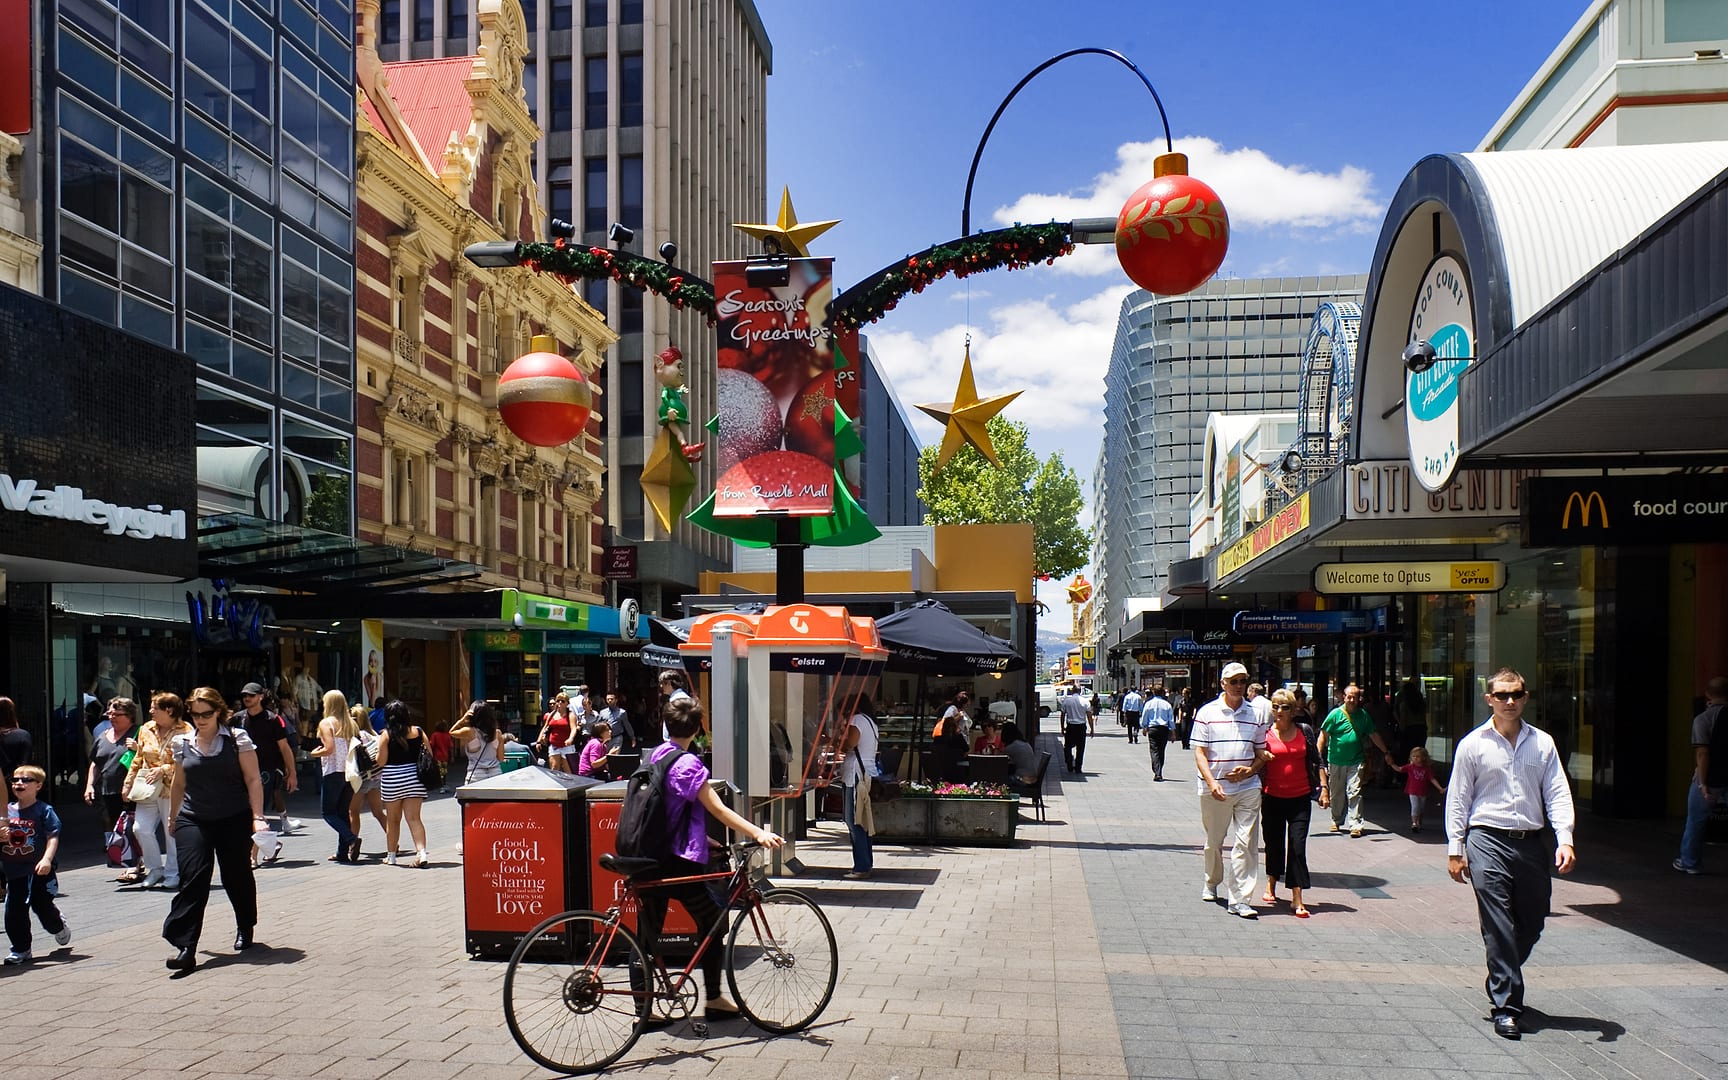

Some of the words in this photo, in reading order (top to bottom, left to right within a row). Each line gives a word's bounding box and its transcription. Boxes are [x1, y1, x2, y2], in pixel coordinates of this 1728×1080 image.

[1436, 270, 1463, 306] COURT
[721, 290, 804, 314] Season's
[731, 320, 830, 349] Greetings
[1425, 441, 1455, 476] SHOPS
[721, 486, 747, 500] from
[751, 485, 794, 499] Rundle
[800, 484, 828, 498] Mall
[1353, 465, 1410, 513] CITI
[0, 473, 186, 540] Valleygirl
[1633, 500, 1677, 516] food
[1253, 521, 1272, 556] NOW
[1273, 501, 1301, 542] OPEN
[1326, 570, 1379, 584] Welcome
[1383, 572, 1394, 584] to
[1397, 570, 1431, 586] Optus
[1241, 622, 1278, 631] Foreign
[1280, 621, 1329, 630] Exchange
[791, 657, 825, 667] Telstra
[471, 817, 524, 829] Christmas
[526, 818, 545, 830] is...
[492, 840, 546, 865] food,
[500, 861, 533, 876] food,
[491, 874, 546, 893] sharing
[496, 892, 544, 915] love.
